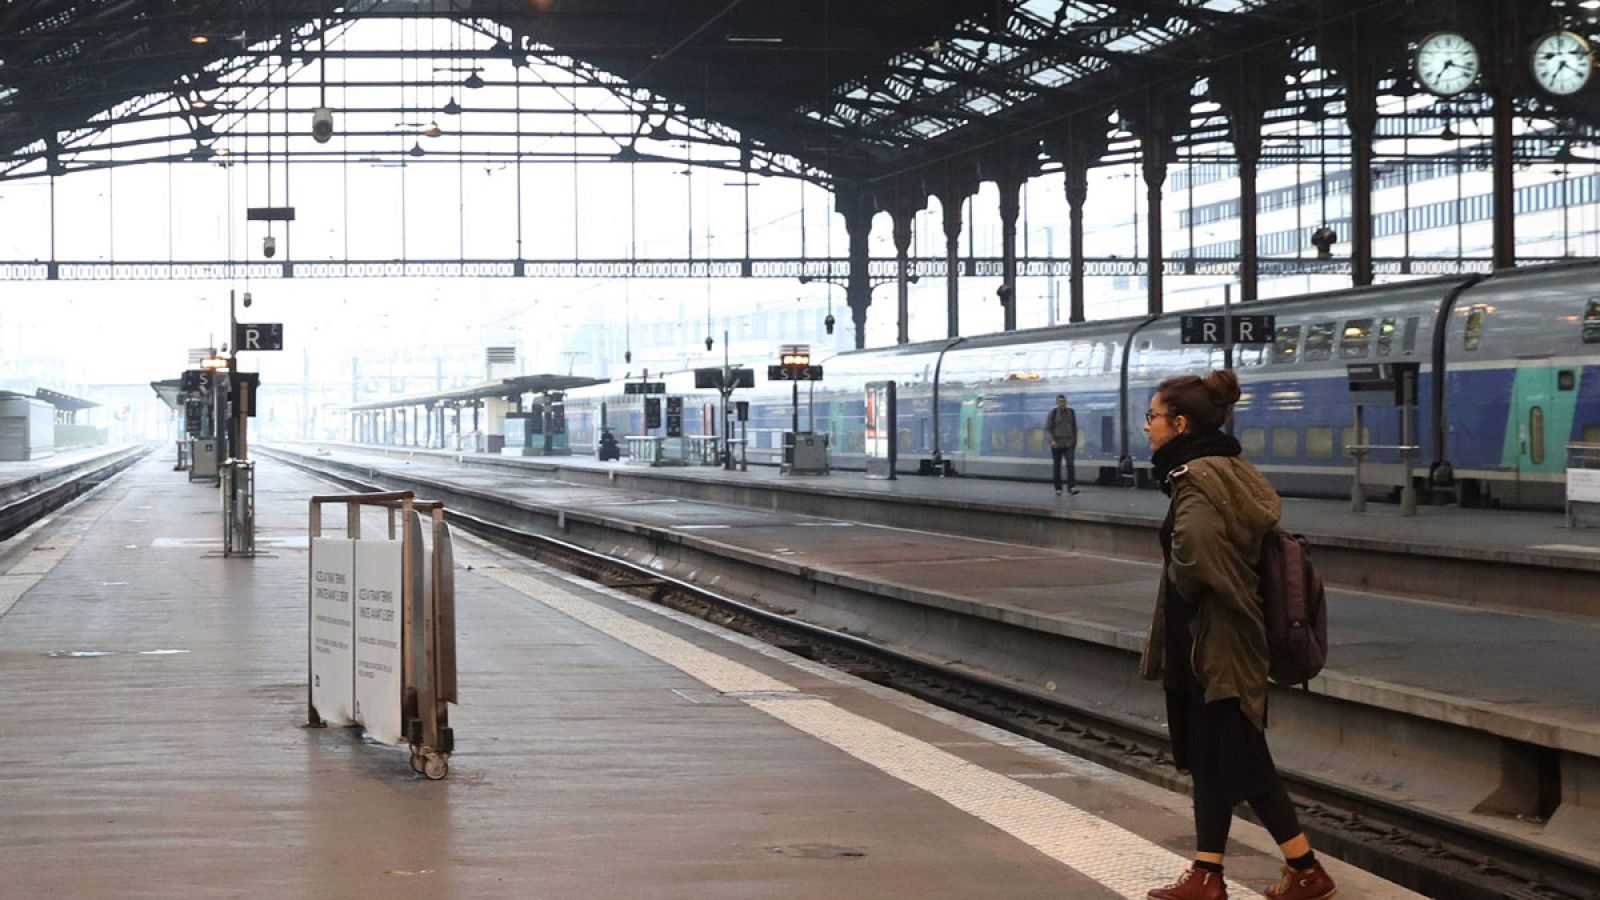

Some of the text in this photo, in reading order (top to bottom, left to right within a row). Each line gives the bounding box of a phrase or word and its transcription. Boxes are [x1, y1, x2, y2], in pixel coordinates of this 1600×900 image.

[246, 329, 260, 349] R
[1203, 322, 1217, 342] R
[1239, 321, 1254, 341] R
[200, 373, 209, 385] S
[780, 368, 811, 380] S S
